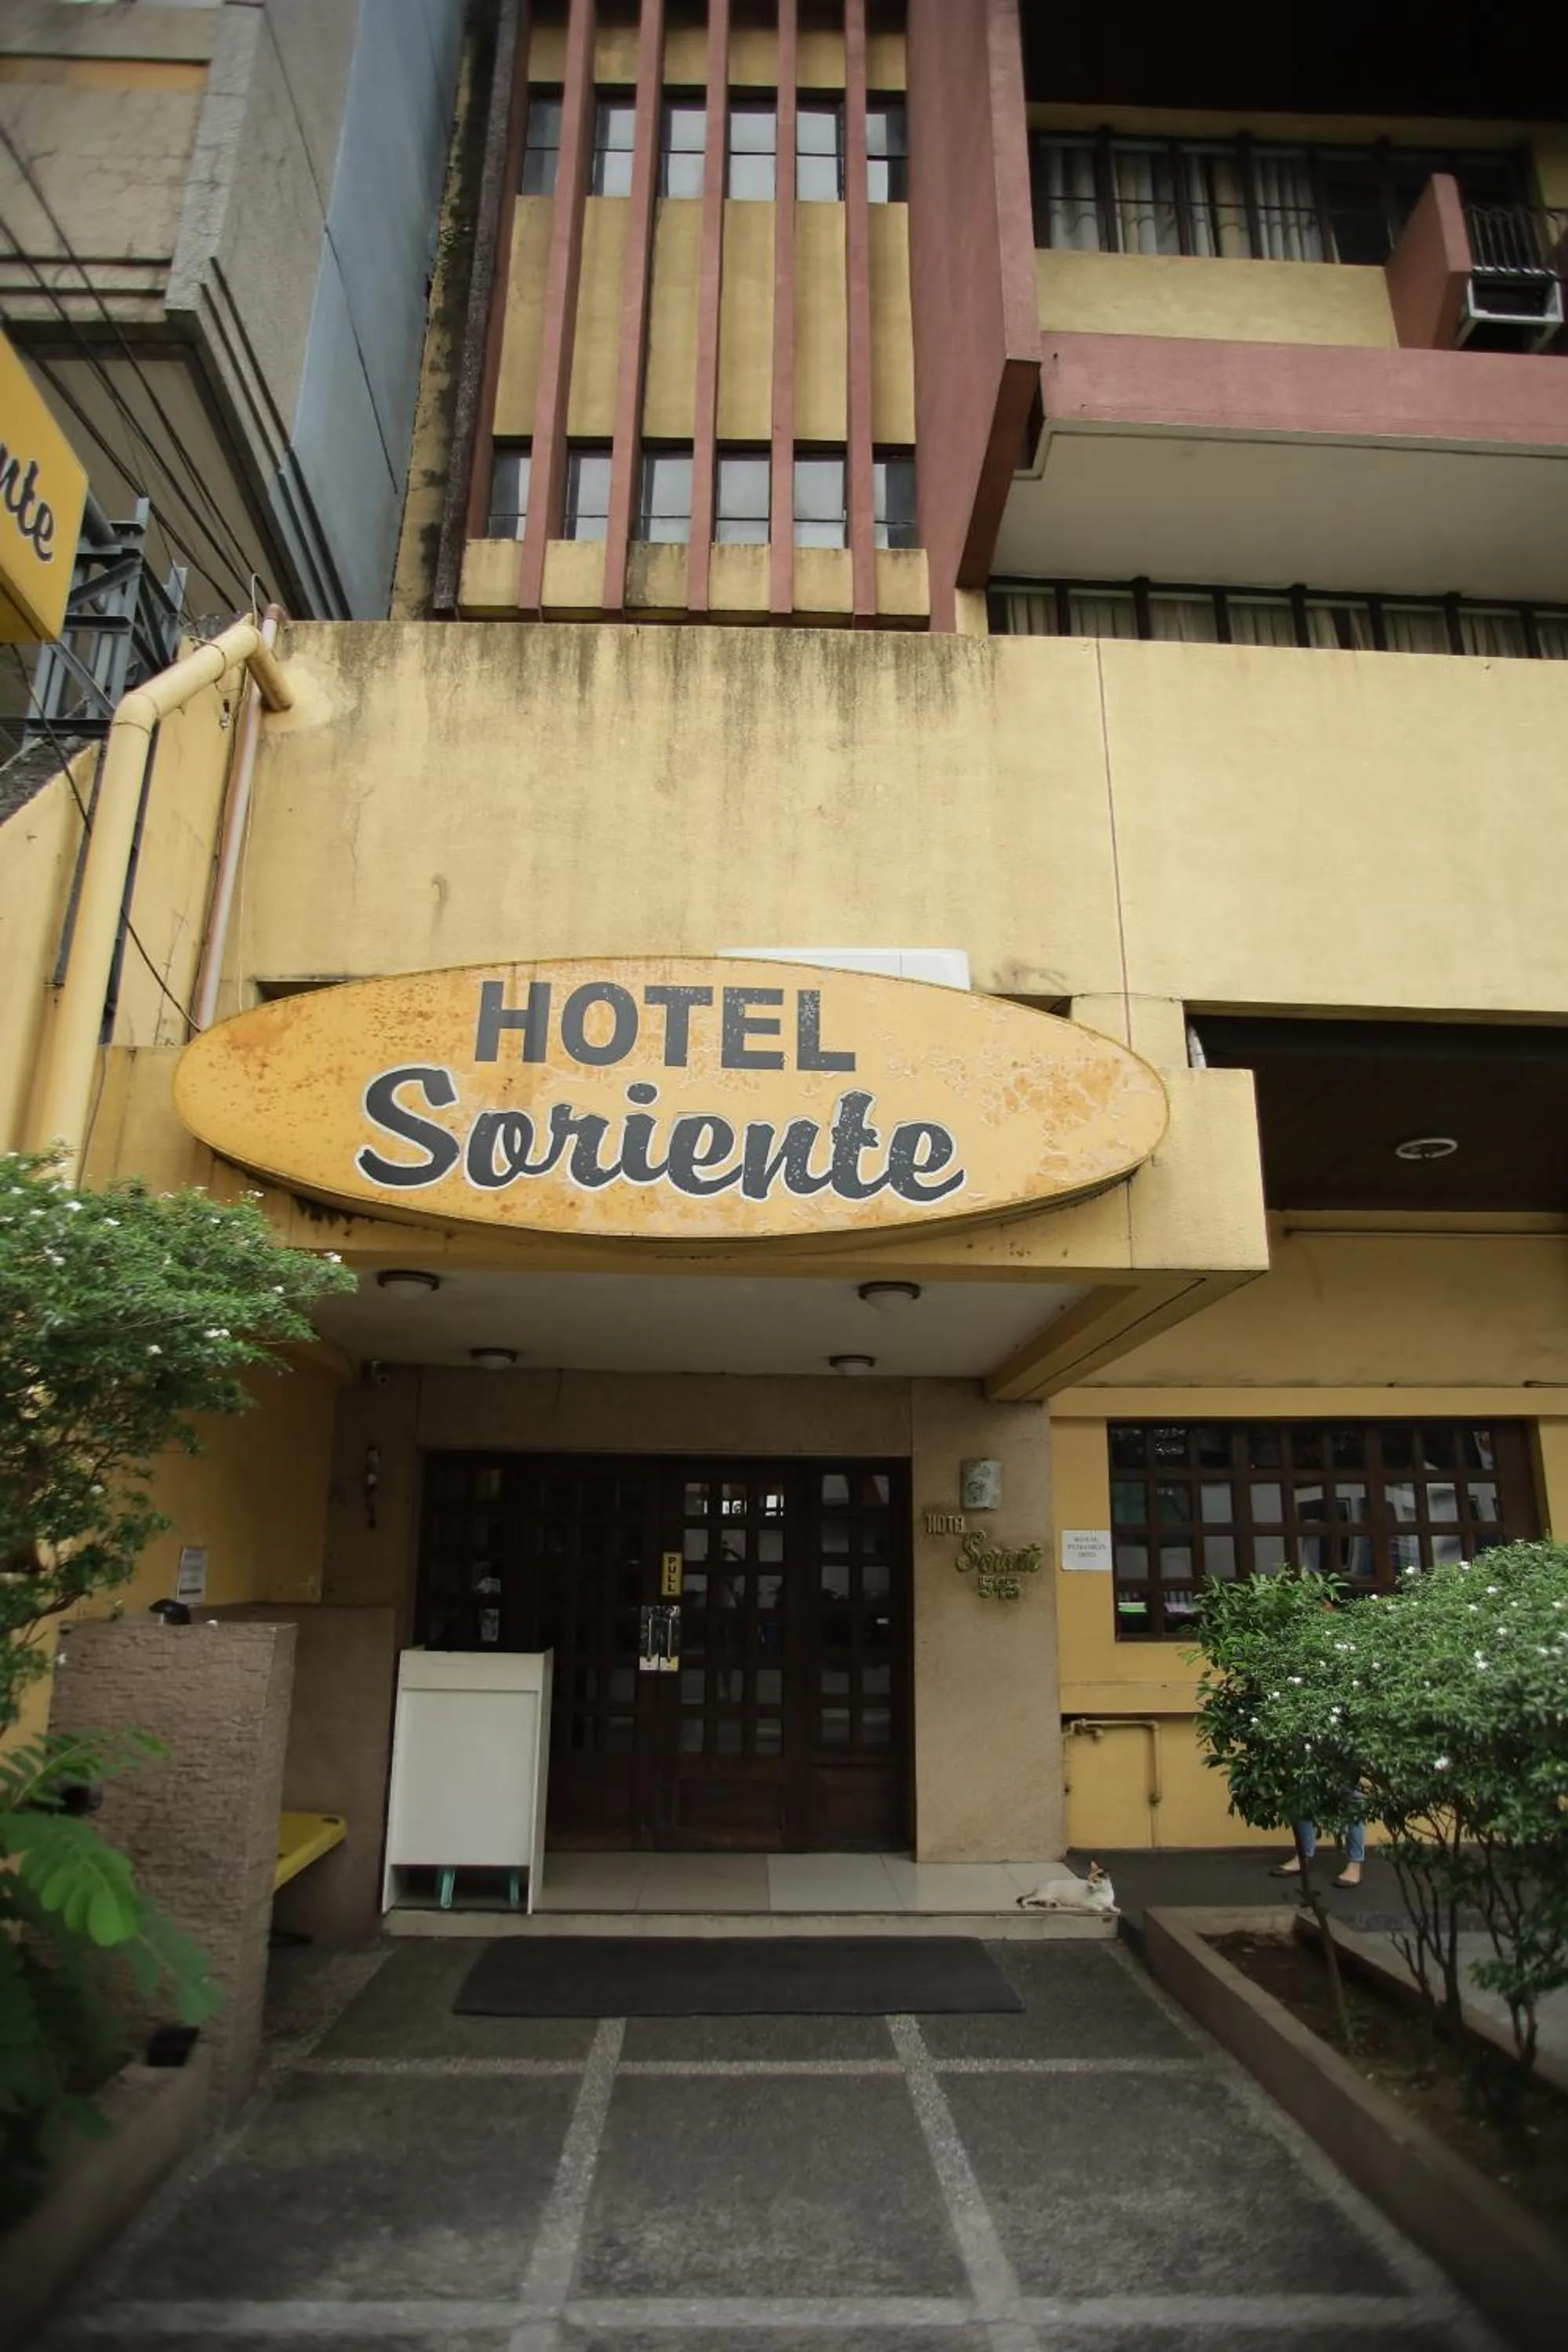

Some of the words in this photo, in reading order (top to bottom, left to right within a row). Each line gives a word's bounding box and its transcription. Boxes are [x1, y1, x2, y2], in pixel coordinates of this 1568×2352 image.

[474, 981, 857, 1072] HOTEL
[355, 1065, 965, 1205] Soriente
[668, 1556, 677, 1592] PULL
